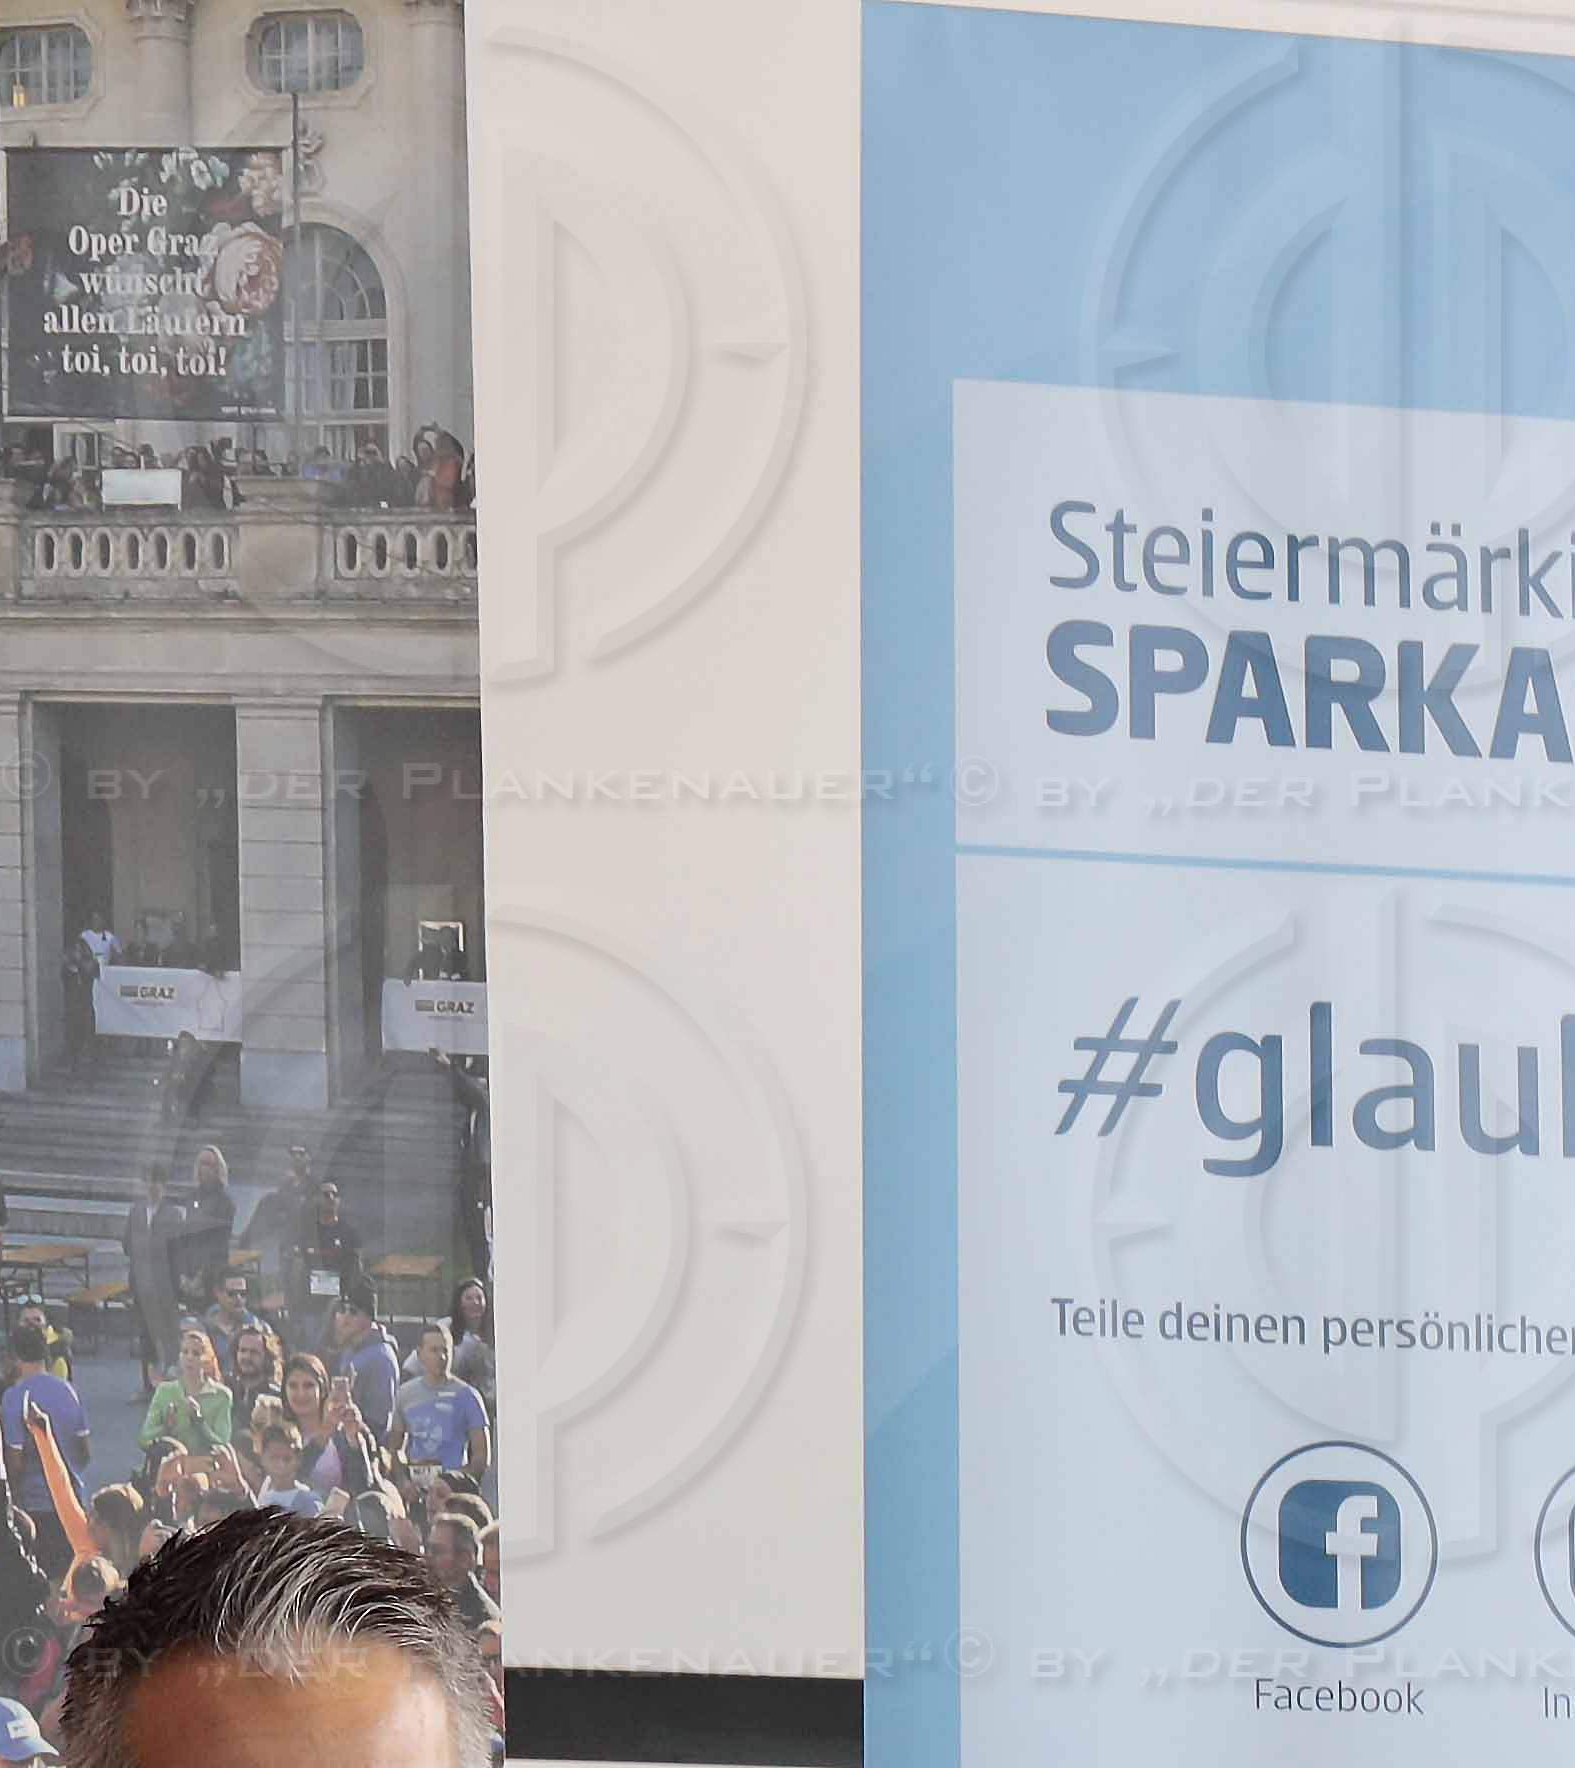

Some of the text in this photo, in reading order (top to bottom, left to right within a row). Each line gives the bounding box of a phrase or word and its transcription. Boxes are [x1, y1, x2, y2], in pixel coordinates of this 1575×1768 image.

[117, 187, 168, 217] Die
[68, 225, 220, 262] Oper Graz
[80, 267, 209, 296] wünscht
[44, 305, 247, 336] allen Läufern
[62, 344, 227, 377] toi, toi, toi!
[1050, 1297, 1146, 1344] Teile
[1158, 1300, 1308, 1348] deinen
[1252, 1675, 1425, 1718] Facebook
